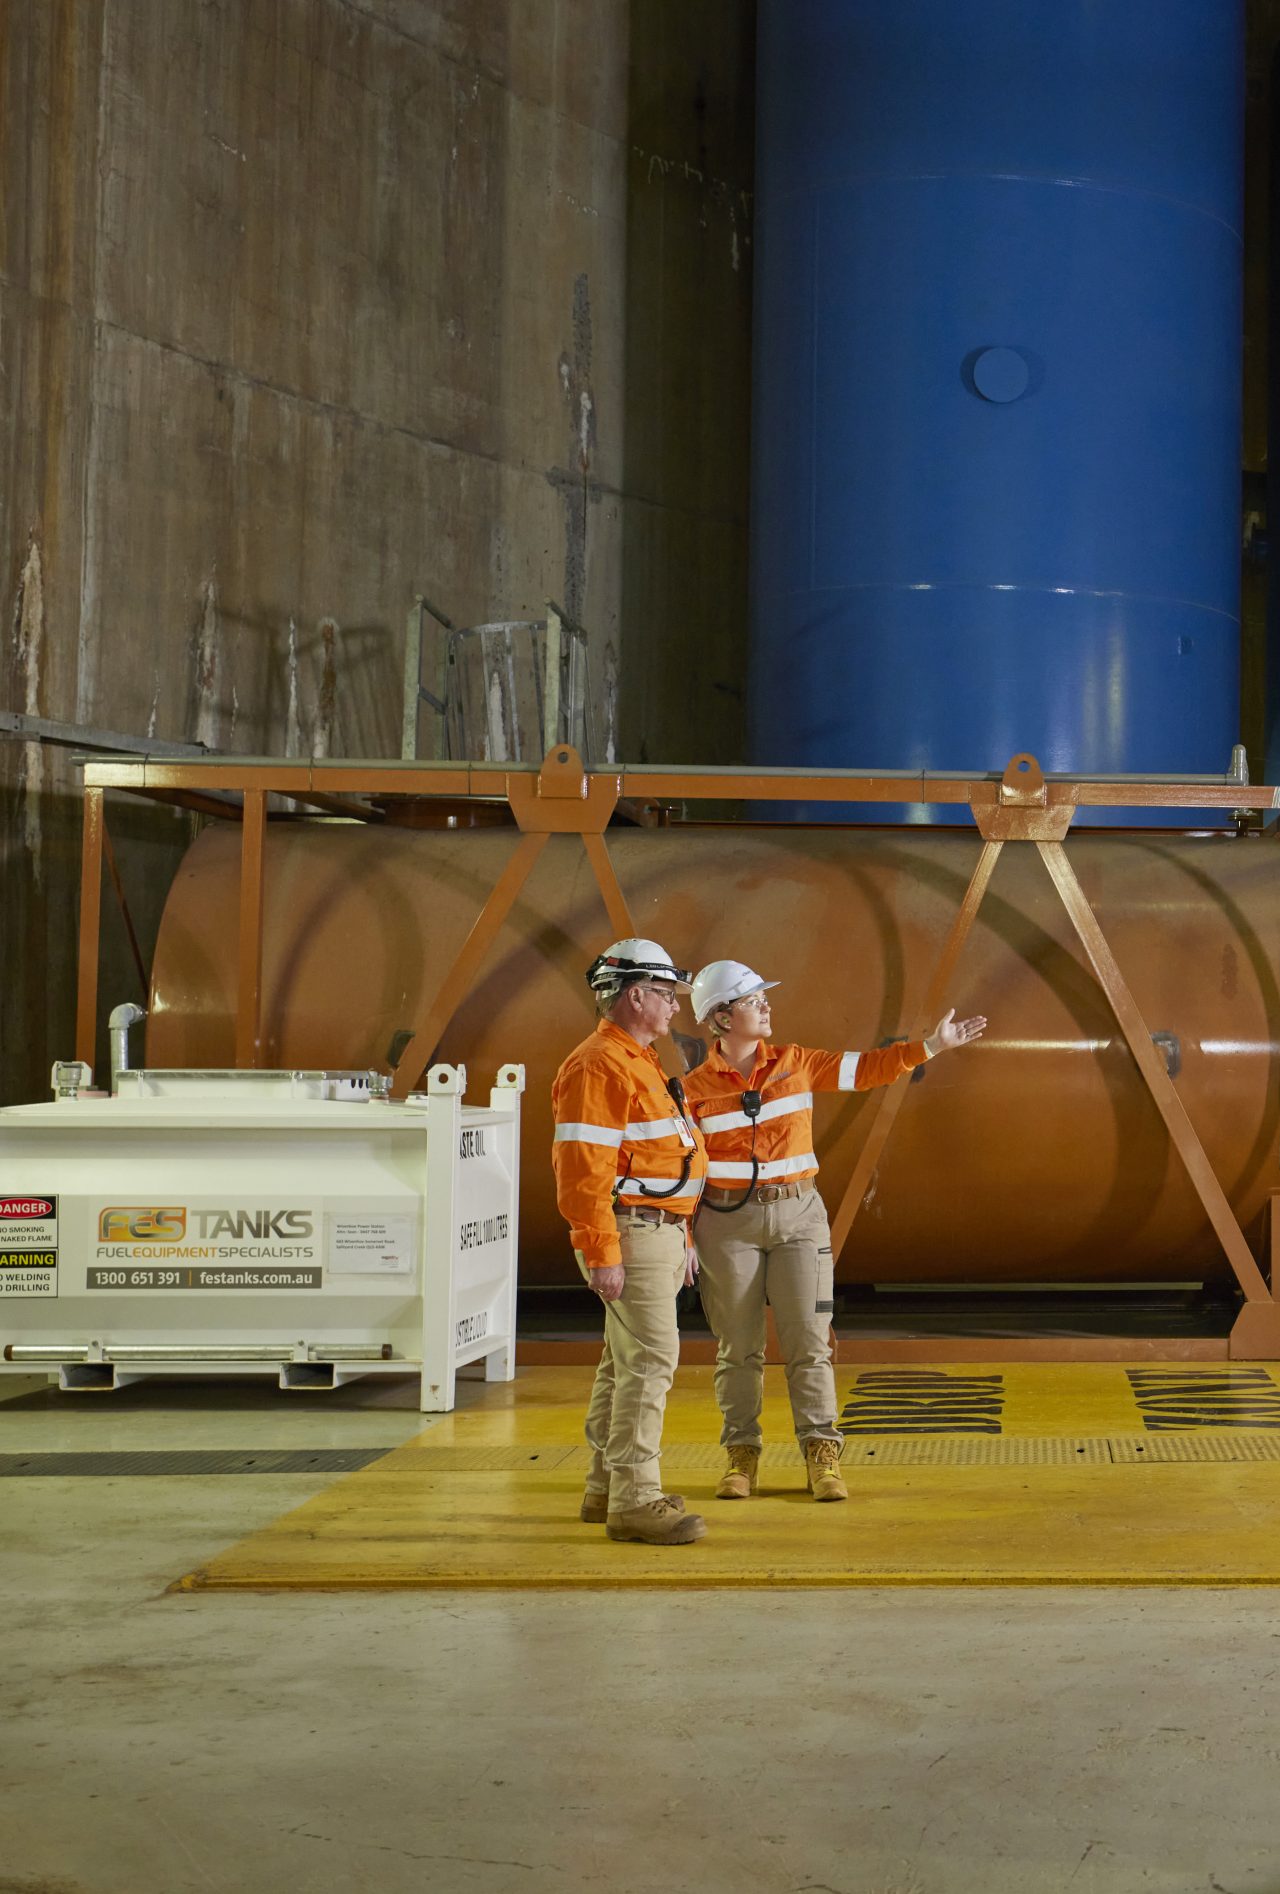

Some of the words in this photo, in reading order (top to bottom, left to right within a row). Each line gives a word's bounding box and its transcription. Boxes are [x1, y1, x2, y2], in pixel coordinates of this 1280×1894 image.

[0, 1203, 47, 1214] ANGER
[190, 1210, 314, 1239] TANKS
[461, 1222, 473, 1250] SAFE
[5, 1273, 51, 1281] WELDING
[95, 1271, 127, 1285] 1300
[130, 1271, 154, 1285] 651
[157, 1271, 181, 1285] 391
[200, 1271, 313, 1285] festanks.com.au
[5, 1284, 50, 1292] DRILLING
[838, 1371, 1006, 1434] DROP
